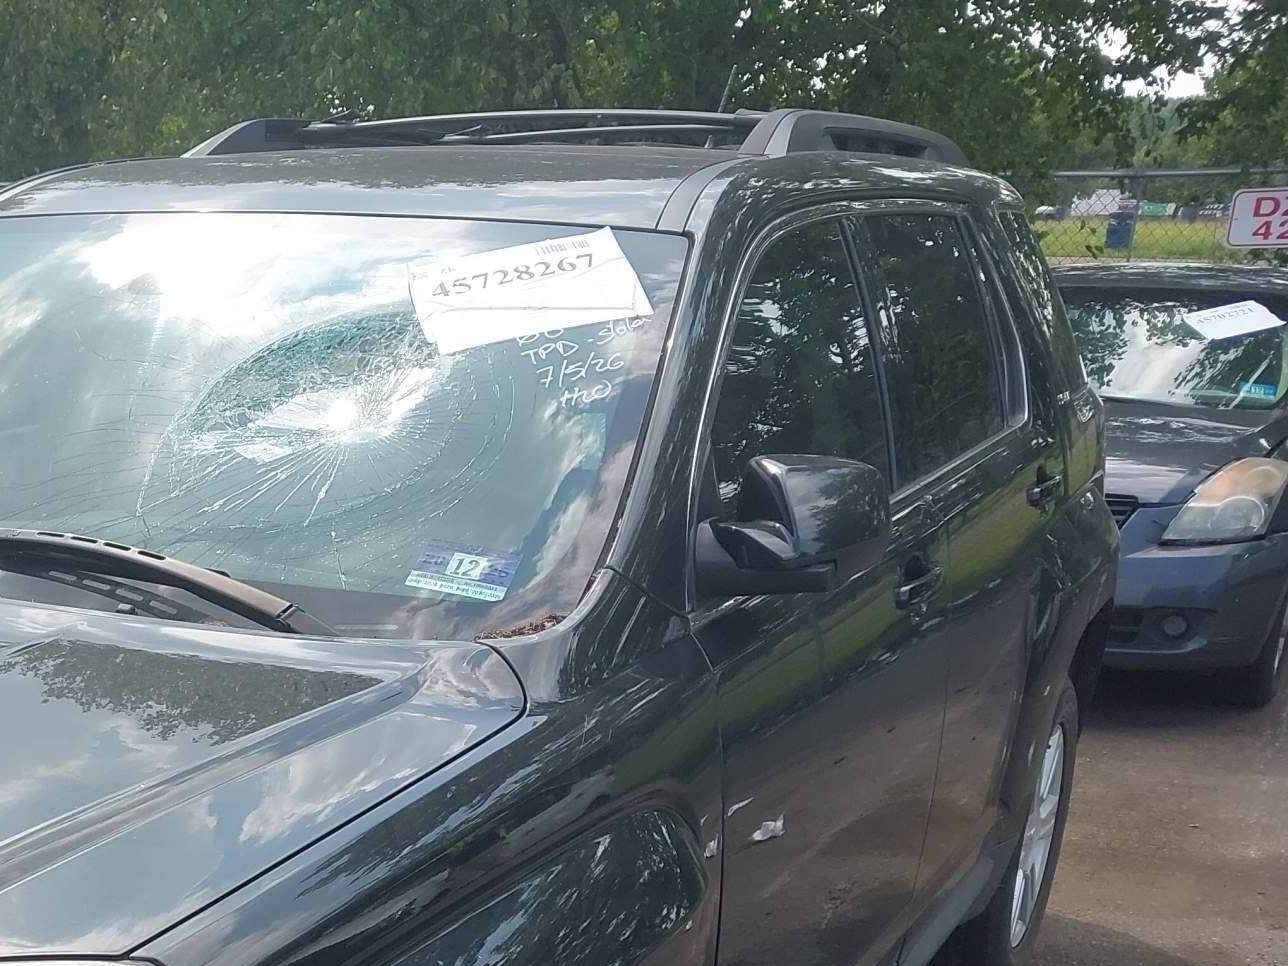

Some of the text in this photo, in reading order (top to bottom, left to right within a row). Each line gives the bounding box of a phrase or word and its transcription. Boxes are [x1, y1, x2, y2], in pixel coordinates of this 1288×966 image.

[431, 252, 594, 297] 45728267
[520, 340, 579, 365] TPD
[535, 351, 625, 389] 7/5/26
[449, 558, 481, 577] 12
